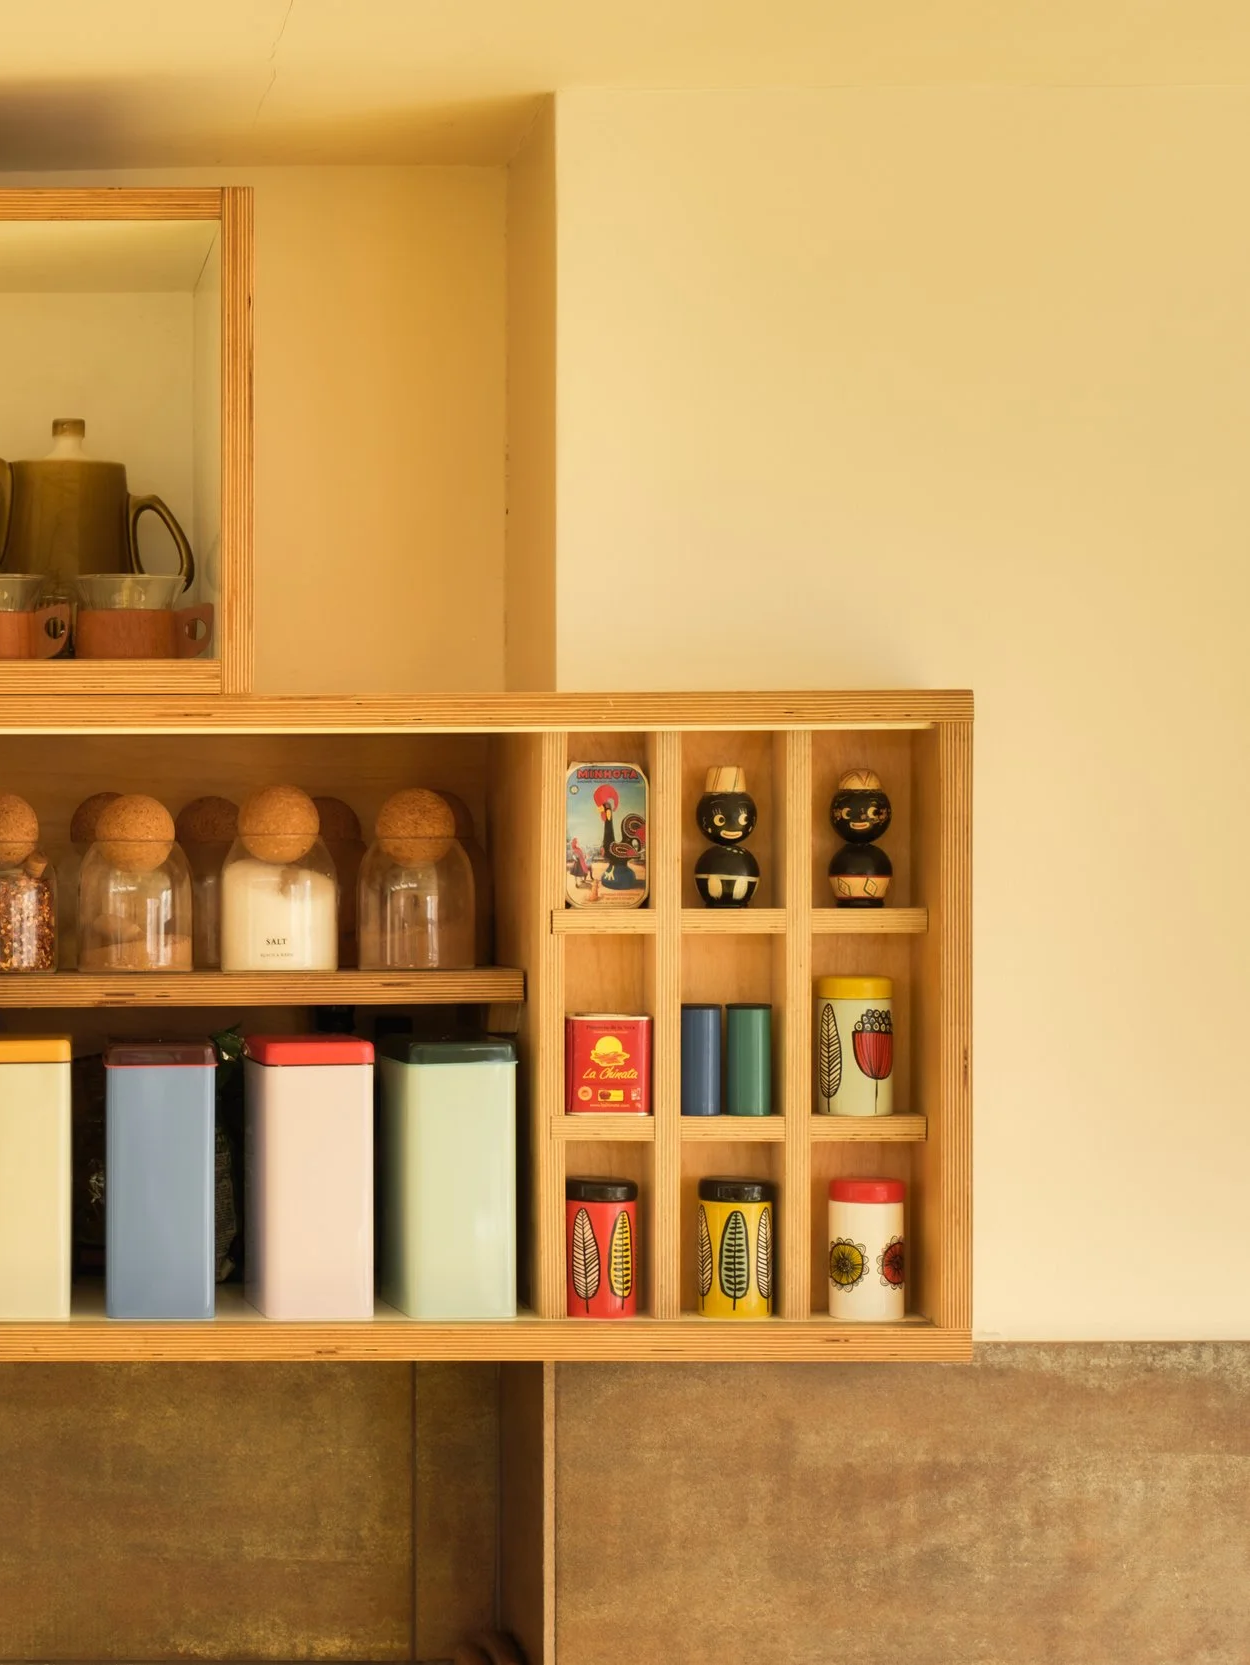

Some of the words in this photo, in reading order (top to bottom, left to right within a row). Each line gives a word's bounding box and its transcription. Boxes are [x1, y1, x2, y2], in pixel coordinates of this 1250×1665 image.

[576, 768, 639, 779] MINHOTA
[265, 938, 287, 946] SALT
[582, 1067, 597, 1079] La
[599, 1066, 639, 1080] Chinata
